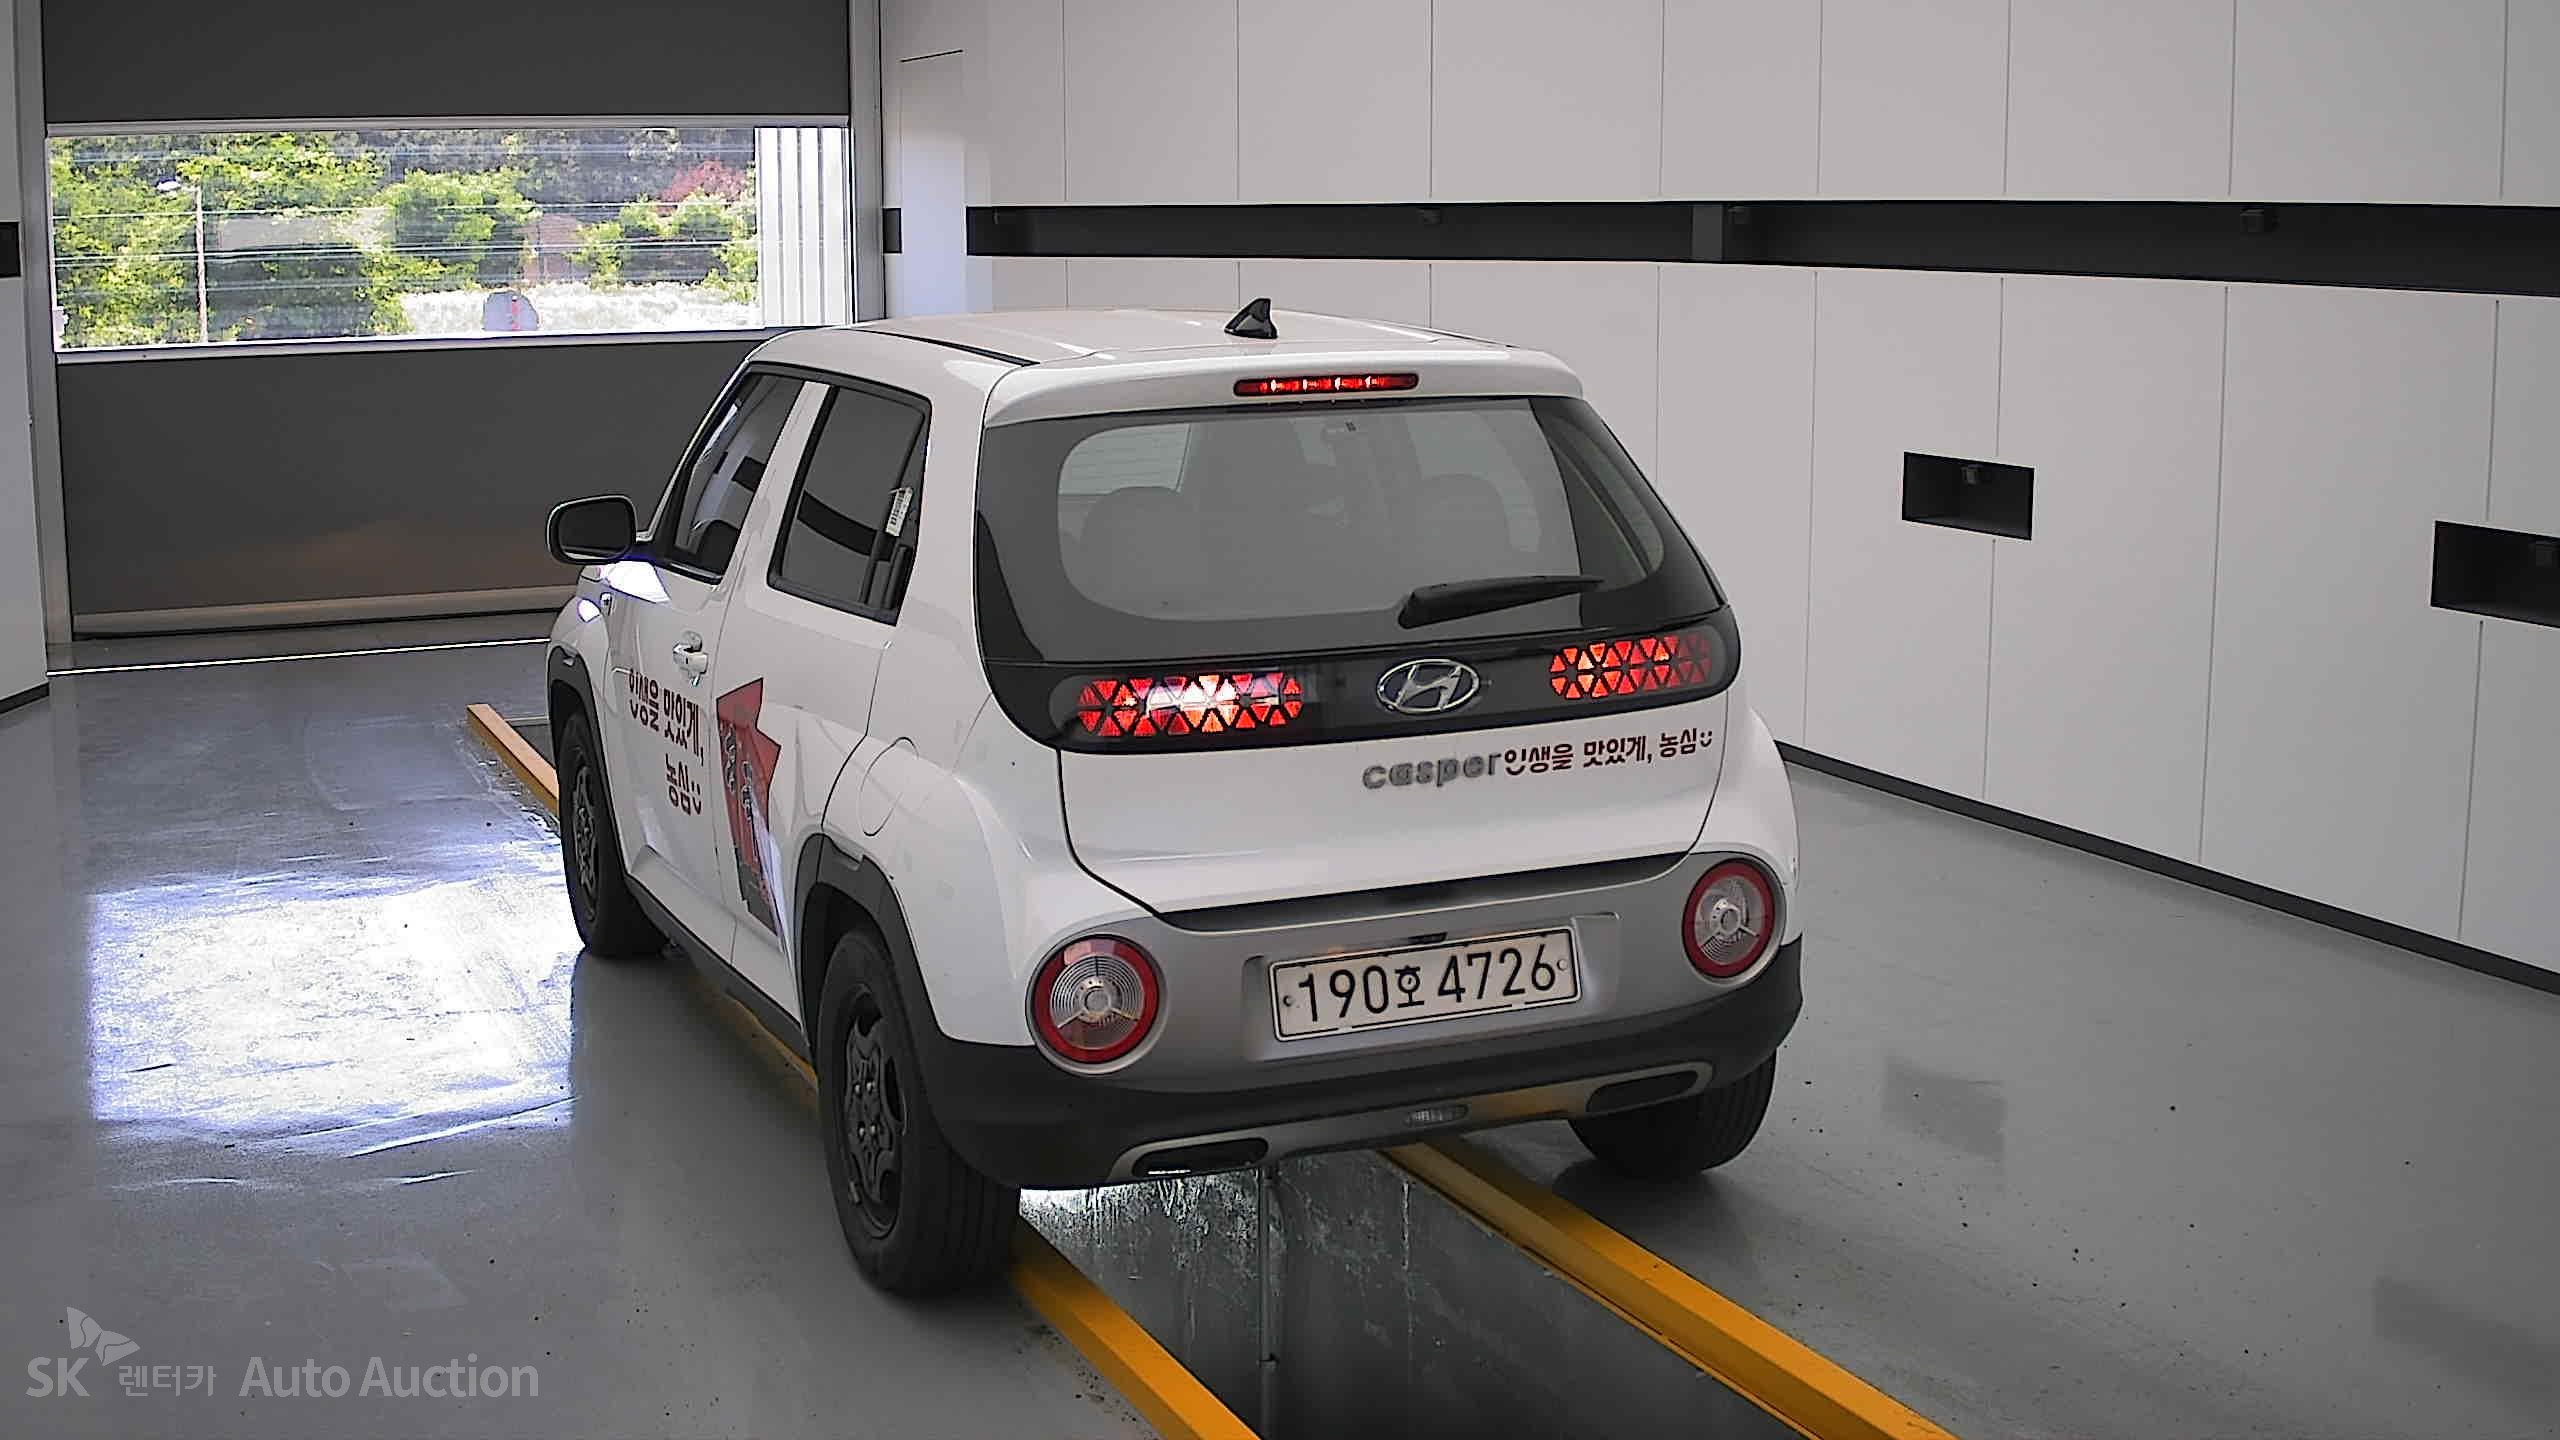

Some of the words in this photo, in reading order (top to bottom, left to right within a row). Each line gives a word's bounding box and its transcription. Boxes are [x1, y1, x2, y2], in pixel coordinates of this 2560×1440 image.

[629, 668, 660, 731] 인생을
[1362, 753, 1501, 789] casper
[1504, 743, 1573, 776] 인생을
[1583, 735, 1652, 767] 맛있게,
[1660, 727, 1698, 758] 농심
[1437, 944, 1555, 1003] 4726
